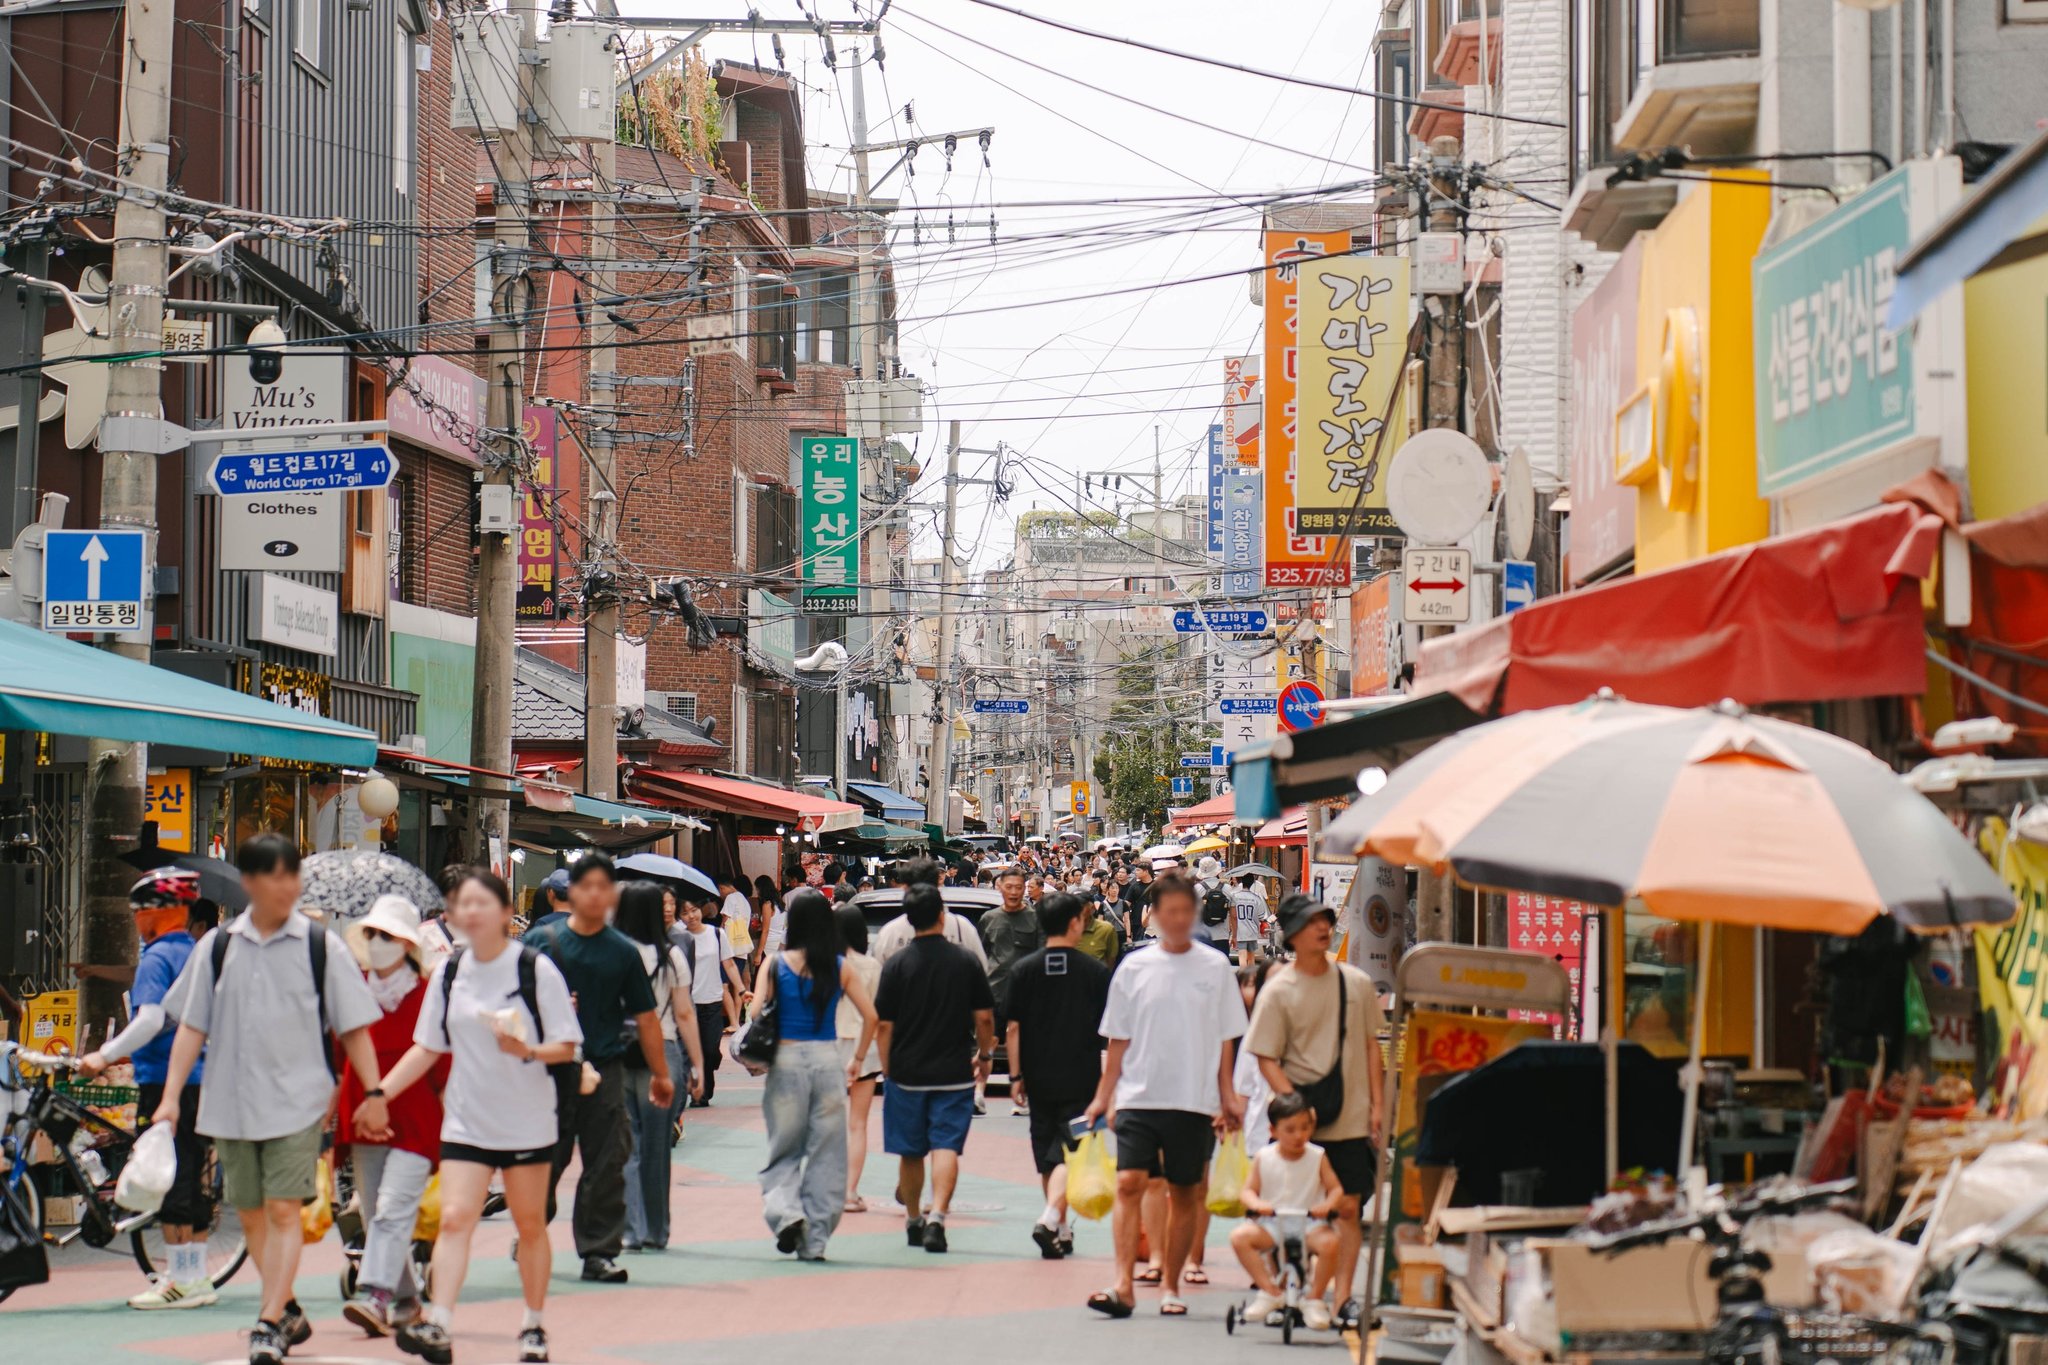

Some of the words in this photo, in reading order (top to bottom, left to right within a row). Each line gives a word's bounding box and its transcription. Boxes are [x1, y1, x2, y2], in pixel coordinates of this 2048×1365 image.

[1769, 245, 1899, 421] 산들건강식품
[1225, 359, 1241, 383] SK
[1319, 272, 1393, 493] 가마로강정
[251, 386, 316, 408] Mu's
[1225, 390, 1236, 447] teecom
[810, 443, 852, 464] 우리
[220, 468, 238, 482] 45
[249, 452, 356, 476] 월드컵로17길
[370, 460, 386, 474] 41
[245, 477, 281, 491] World
[283, 476, 326, 490] Cup-ro
[328, 472, 363, 486] 17-gil
[247, 502, 318, 515] Clothes
[1301, 514, 1335, 527] 망원점
[1338, 514, 1398, 527] 35-743
[811, 470, 850, 589] 농산물
[274, 543, 288, 554] 2F
[1232, 509, 1253, 607] 참좋은한
[51, 602, 137, 626] 일방통행
[805, 598, 858, 611] 337-2519
[1420, 602, 1453, 615] 442m
[1237, 660, 1256, 742] 시장주
